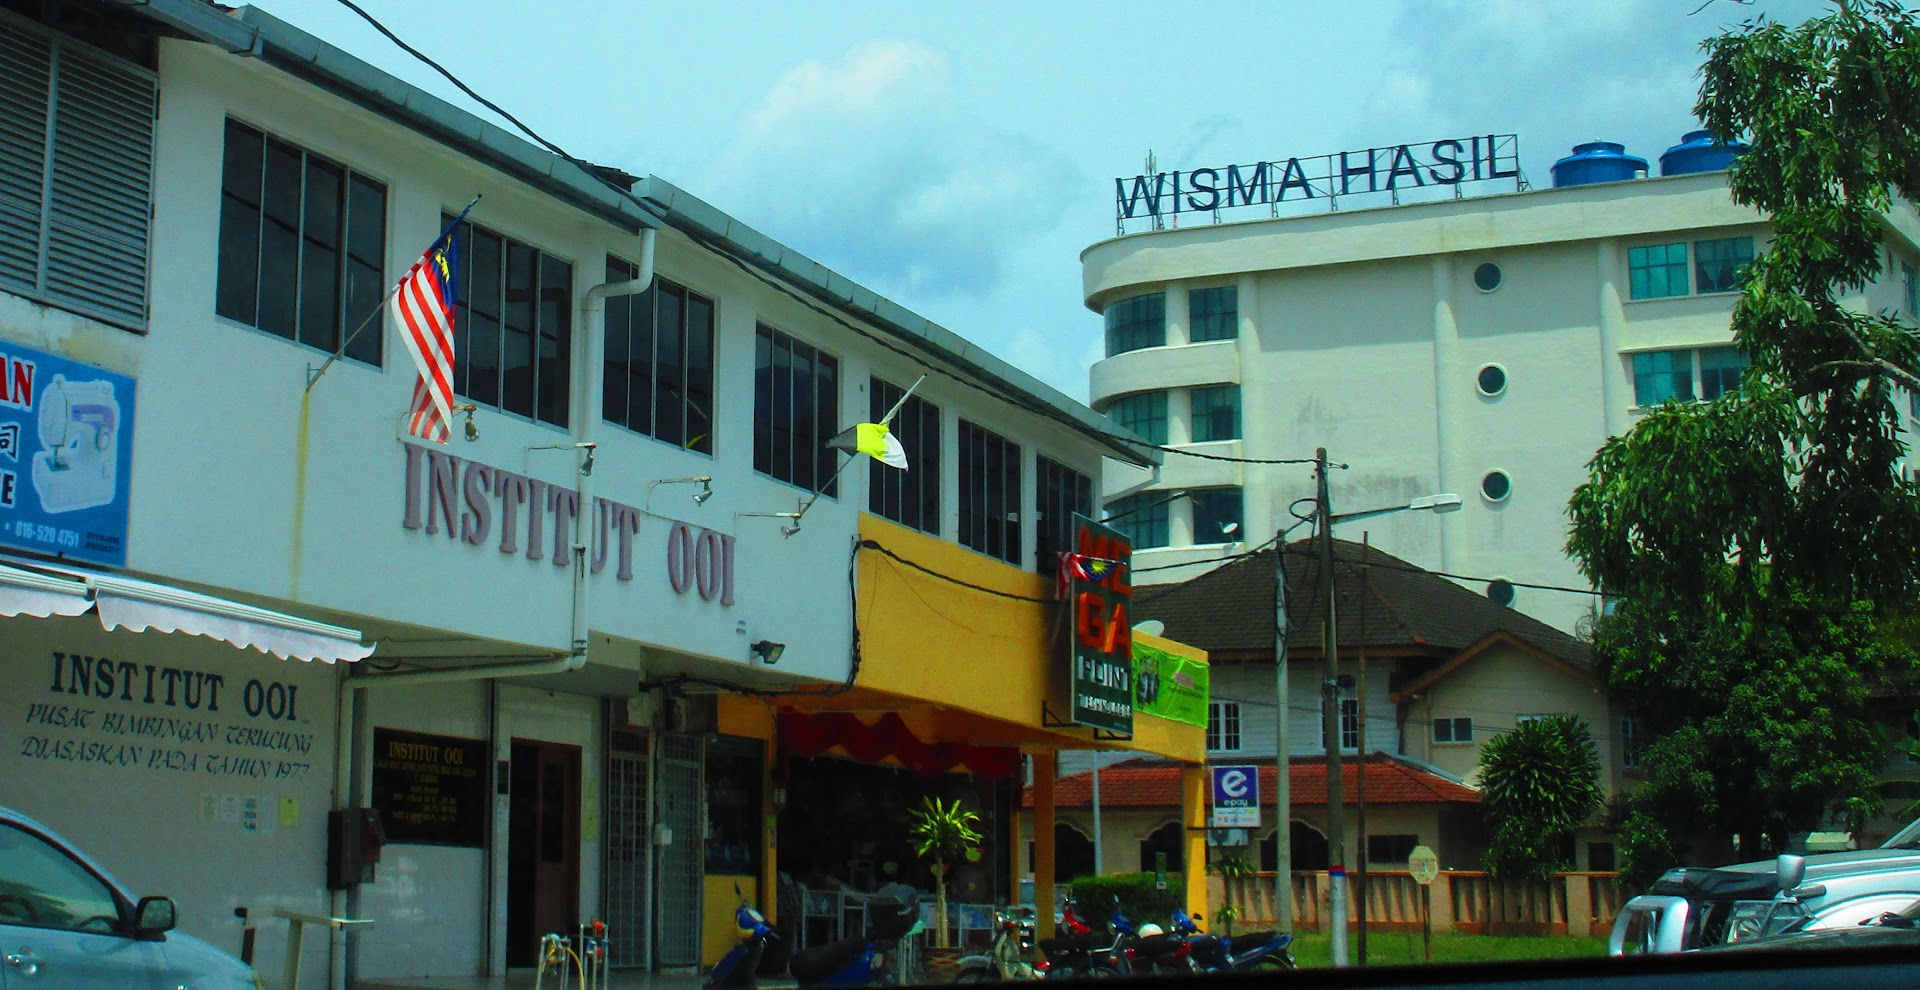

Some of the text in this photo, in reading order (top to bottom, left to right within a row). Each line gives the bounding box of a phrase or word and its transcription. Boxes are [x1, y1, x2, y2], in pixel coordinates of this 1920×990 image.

[1116, 134, 1519, 219] WISMA HASIL
[57, 528, 80, 548] 4751
[403, 441, 736, 606] INSTITUT OOI
[1077, 592, 1133, 659] GA
[51, 652, 298, 721] INSTITUT OOI
[25, 703, 95, 730] PUSAT
[101, 712, 219, 744] BIMBINGAN
[21, 736, 311, 781] DIASASKAN PADA TAHUN 1977
[389, 742, 464, 765] INSTITUT OOI
[1223, 799, 1248, 807] epay
